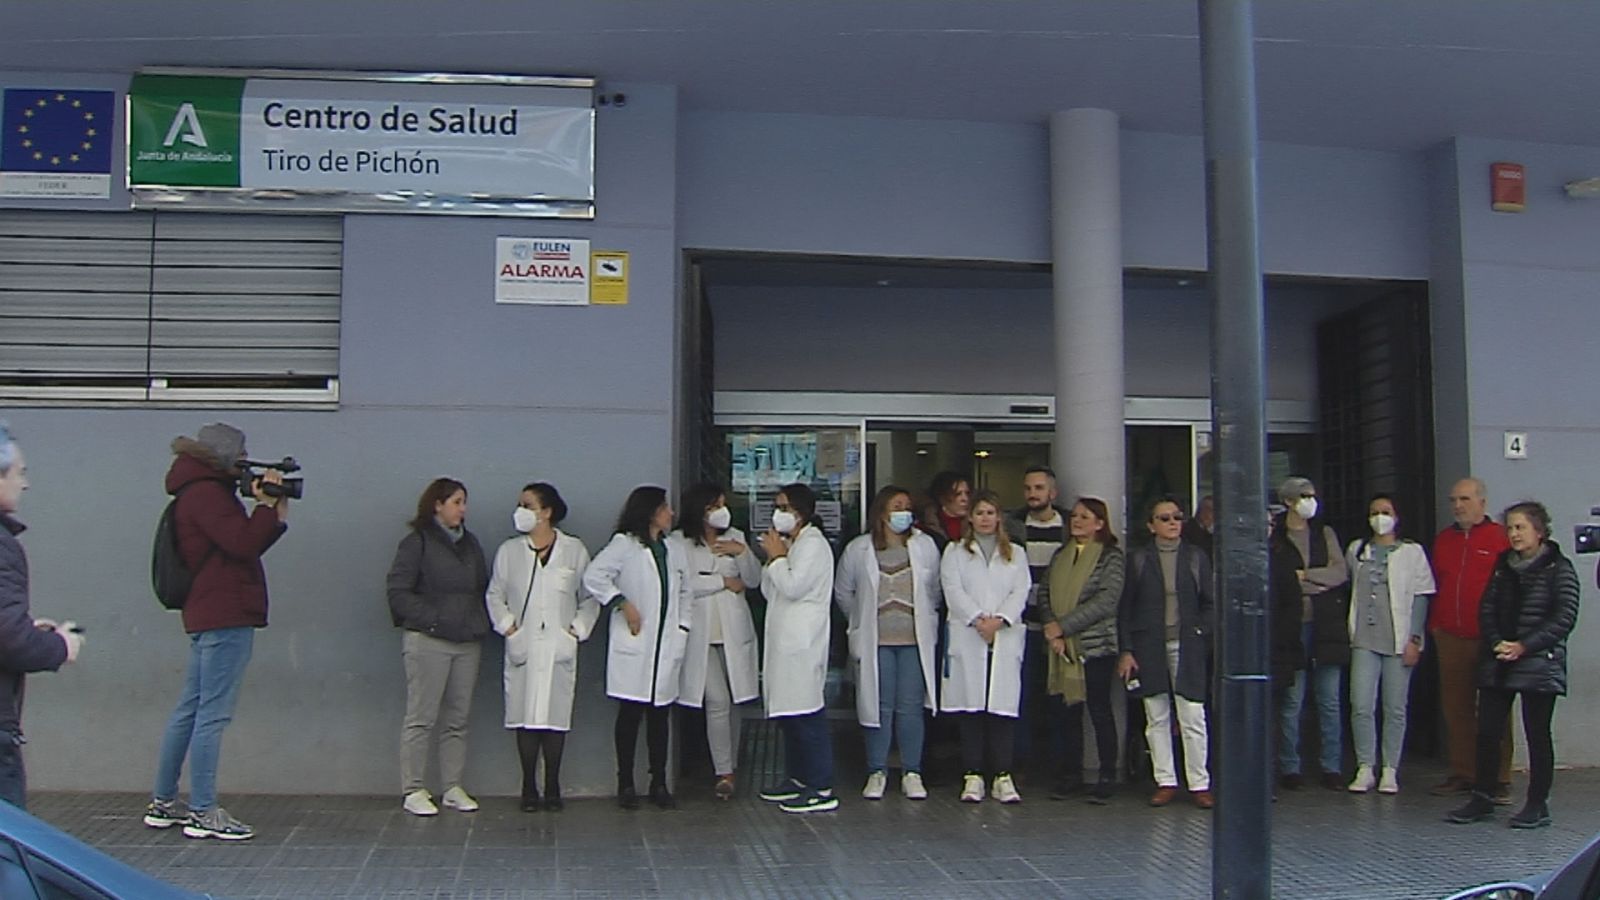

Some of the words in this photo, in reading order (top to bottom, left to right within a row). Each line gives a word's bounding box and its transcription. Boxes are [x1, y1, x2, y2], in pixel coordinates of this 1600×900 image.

[263, 102, 371, 131] Centro
[380, 105, 419, 132] de
[428, 107, 518, 135] Salud
[136, 151, 166, 161] Junta
[167, 152, 181, 161] de
[263, 150, 311, 171] Tiro
[318, 150, 348, 172] de
[356, 151, 440, 174] Pichón
[500, 264, 584, 279] ALARMA
[1510, 437, 1521, 453] 4
